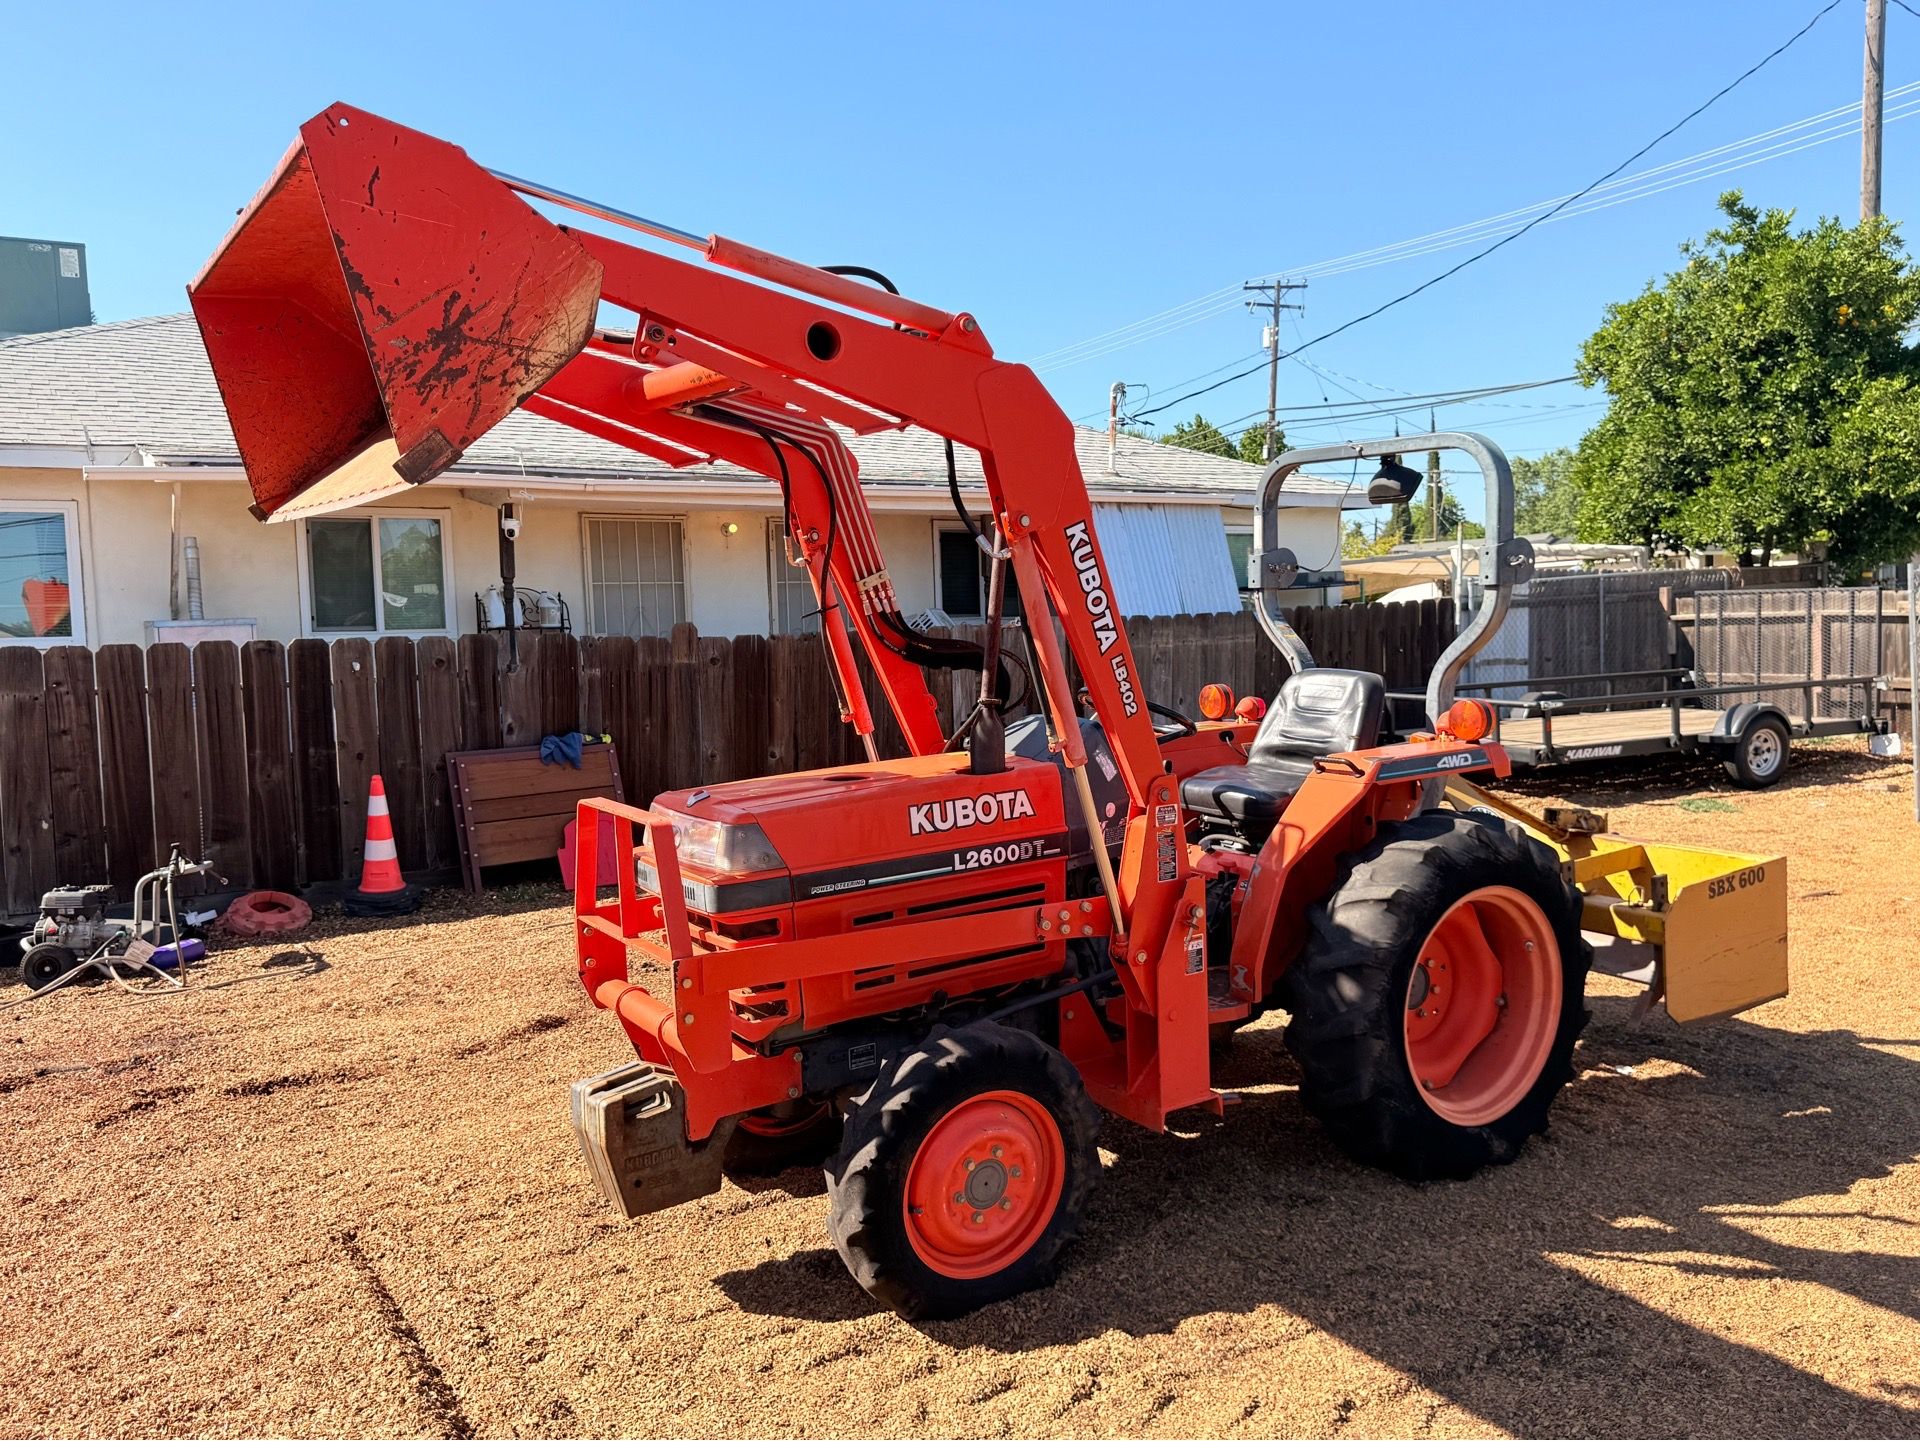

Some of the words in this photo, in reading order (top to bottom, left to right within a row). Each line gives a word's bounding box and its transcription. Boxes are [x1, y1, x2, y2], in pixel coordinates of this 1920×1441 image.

[1064, 520, 1118, 656] KUBOTA
[1110, 653, 1138, 718] LB402
[1436, 753, 1472, 769] 4WD
[1566, 745, 1623, 760] KARAVAN
[909, 788, 1036, 836] KUBOTA
[953, 839, 1045, 871] L2600DT
[811, 884, 834, 894] POWER
[835, 879, 866, 890] STEERING
[1708, 875, 1736, 899] SBX
[1738, 866, 1765, 888] 600
